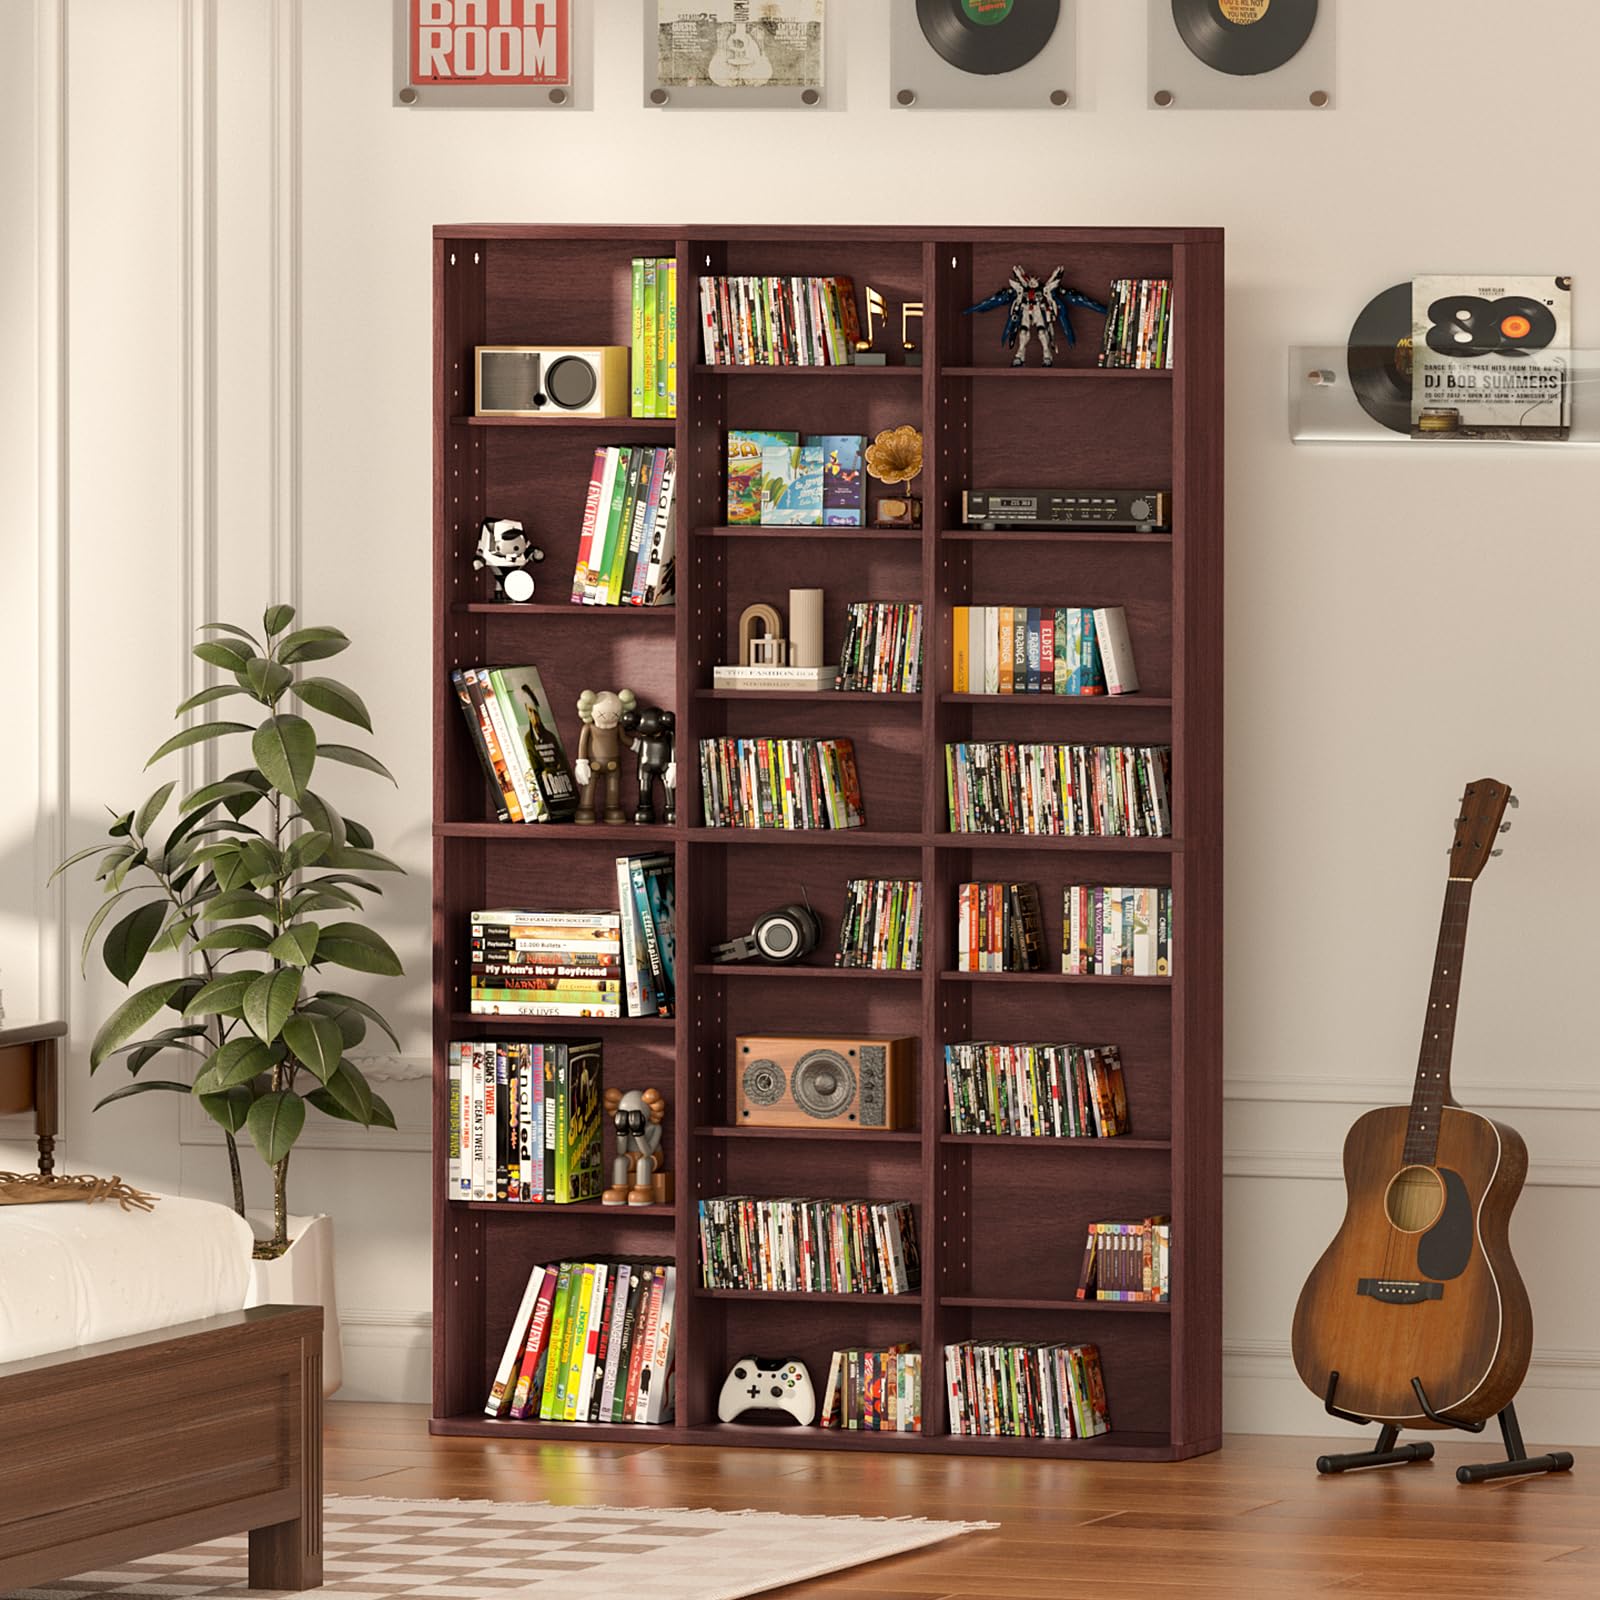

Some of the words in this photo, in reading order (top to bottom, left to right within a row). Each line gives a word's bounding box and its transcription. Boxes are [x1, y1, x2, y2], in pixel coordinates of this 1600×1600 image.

[419, 26, 557, 76] ROOM
[1424, 375, 1441, 388] DJ
[1447, 375, 1477, 388] BOB
[1482, 375, 1558, 389] SUMMERS
[650, 475, 671, 565] nailed
[1041, 628, 1053, 663] ELDEST
[485, 965, 500, 975] My
[502, 965, 533, 975] Mom's
[535, 966, 556, 975] New
[558, 966, 607, 977] Boyfriend
[647, 936, 661, 977] Papillon
[504, 978, 548, 990] NARNIA
[518, 1007, 534, 1015] SEX
[485, 1050, 495, 1084] OCEAN'S
[474, 1099, 484, 1132] OCEAN'S
[485, 1084, 495, 1116] TWELVE
[519, 1073, 531, 1161] nailed
[474, 1133, 484, 1161] TWELVE
[646, 1291, 663, 1338] CHRISTMAS
[642, 1338, 656, 1362] CAROL
[605, 1361, 617, 1394] HEART
